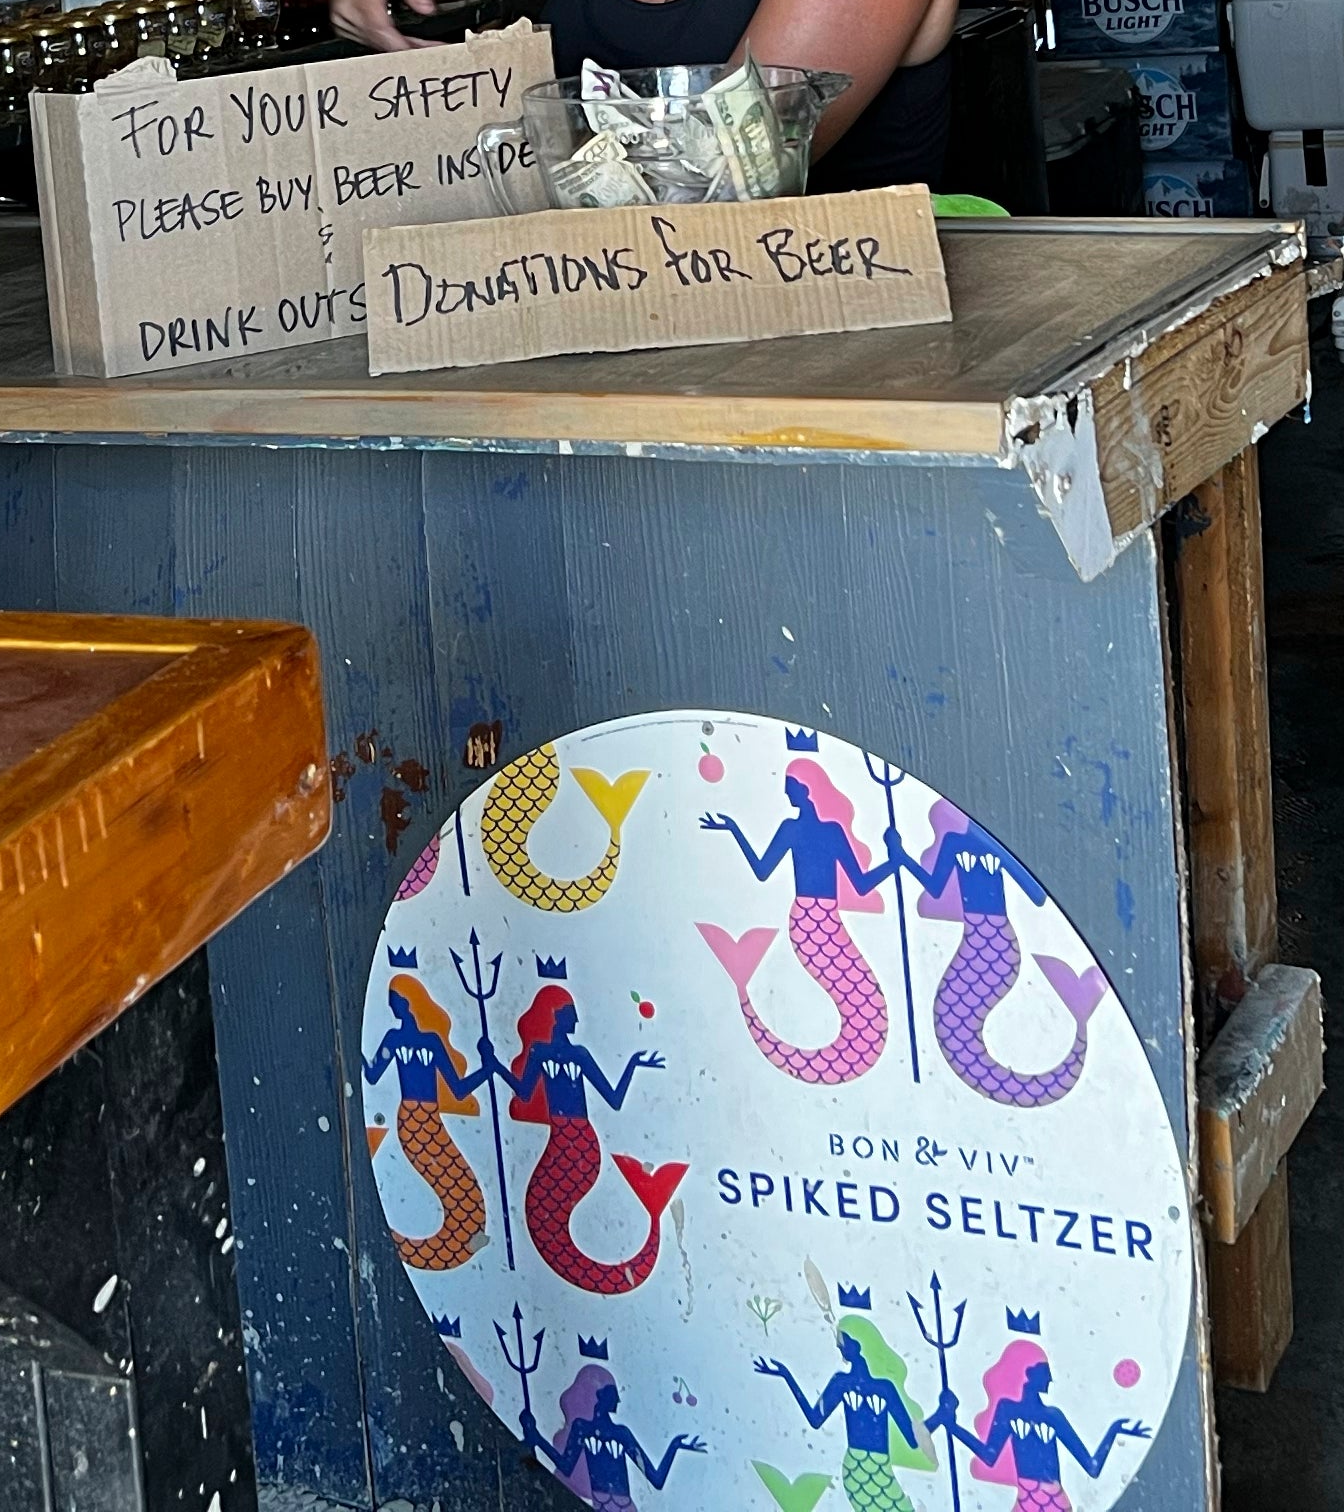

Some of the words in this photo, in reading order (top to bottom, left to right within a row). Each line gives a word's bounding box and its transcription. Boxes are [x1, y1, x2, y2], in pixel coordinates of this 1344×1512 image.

[1105, 14, 1162, 31] LIGHT
[111, 98, 214, 159] FOR
[229, 85, 348, 144] YOUR
[368, 66, 514, 120] SAFETY
[1137, 93, 1195, 121] SCH
[1138, 122, 1177, 138] GHT
[112, 188, 244, 243] PLEASE
[332, 159, 422, 207] BEER
[436, 140, 536, 187] INSIDE
[382, 246, 648, 327] DONATIONS
[756, 227, 914, 284] BEER
[138, 305, 264, 362] DRINK
[278, 281, 368, 335] OUTS
[829, 1133, 900, 1163] BON
[914, 1135, 949, 1167] &
[717, 1168, 901, 1225] SPIKED
[925, 1191, 1155, 1262] SELTZER
